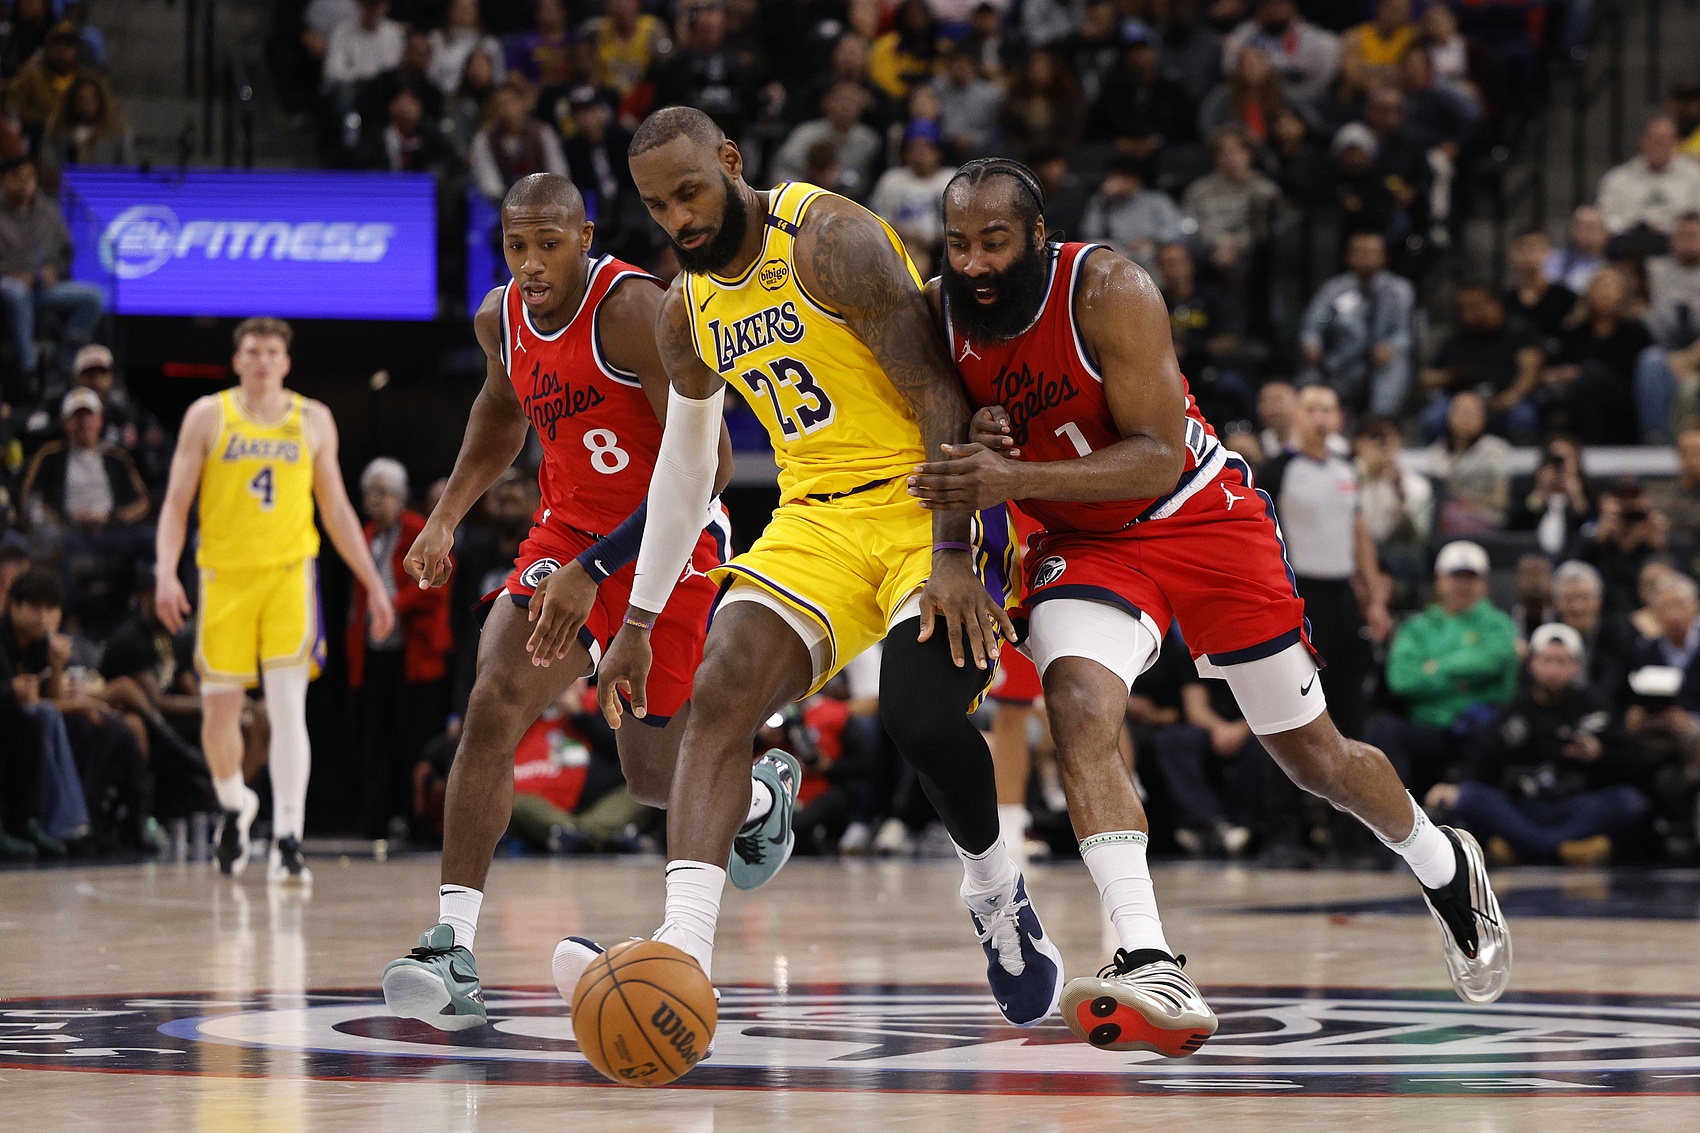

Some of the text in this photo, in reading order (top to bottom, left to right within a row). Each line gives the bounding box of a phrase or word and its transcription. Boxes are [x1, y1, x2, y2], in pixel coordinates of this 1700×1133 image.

[173, 221, 395, 263] FITNESS
[761, 267, 787, 282] bibigo
[707, 300, 806, 375] LAKERS
[531, 360, 563, 400] Los
[740, 356, 836, 442] 23
[992, 361, 1035, 407] Los
[523, 382, 606, 442] Angeles
[1009, 371, 1080, 447] geles
[582, 428, 631, 475] 8
[1054, 421, 1093, 458] 1
[249, 465, 275, 509] 4
[651, 1001, 700, 1069] Wilso
